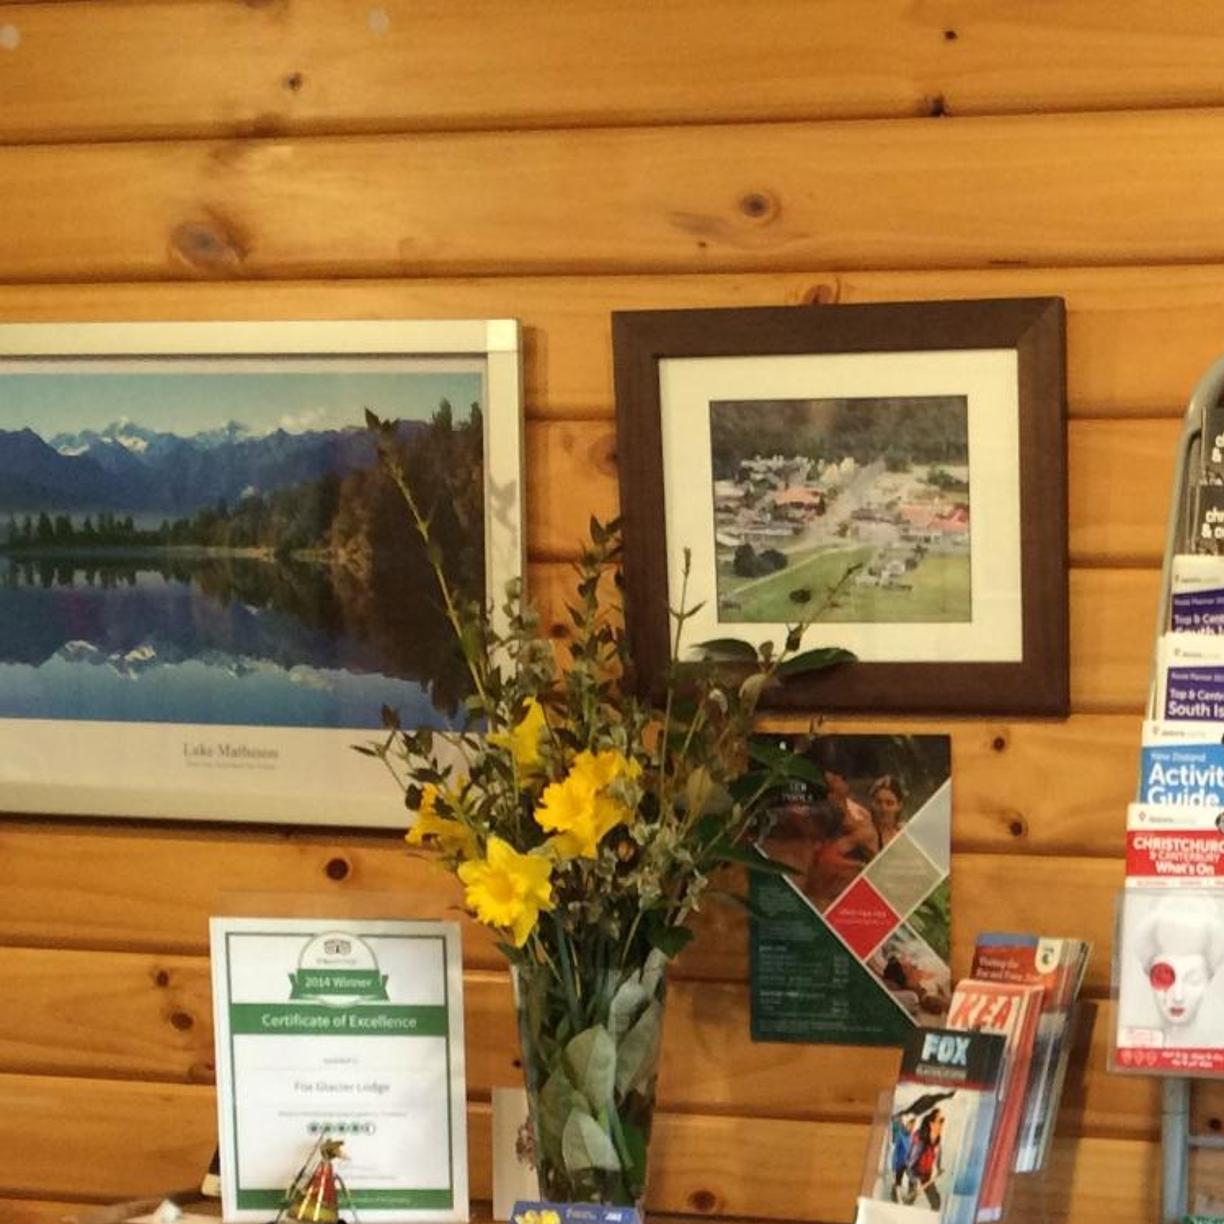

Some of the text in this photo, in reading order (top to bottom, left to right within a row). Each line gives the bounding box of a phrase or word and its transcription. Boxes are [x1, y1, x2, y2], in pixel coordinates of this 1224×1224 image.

[1170, 689, 1190, 701] Top
[1168, 701, 1211, 716] South
[1147, 789, 1220, 807] Guide
[305, 977, 371, 988] 2014 Winner
[262, 1013, 417, 1028] Certificate of Excellence
[921, 1034, 970, 1066] FOX
